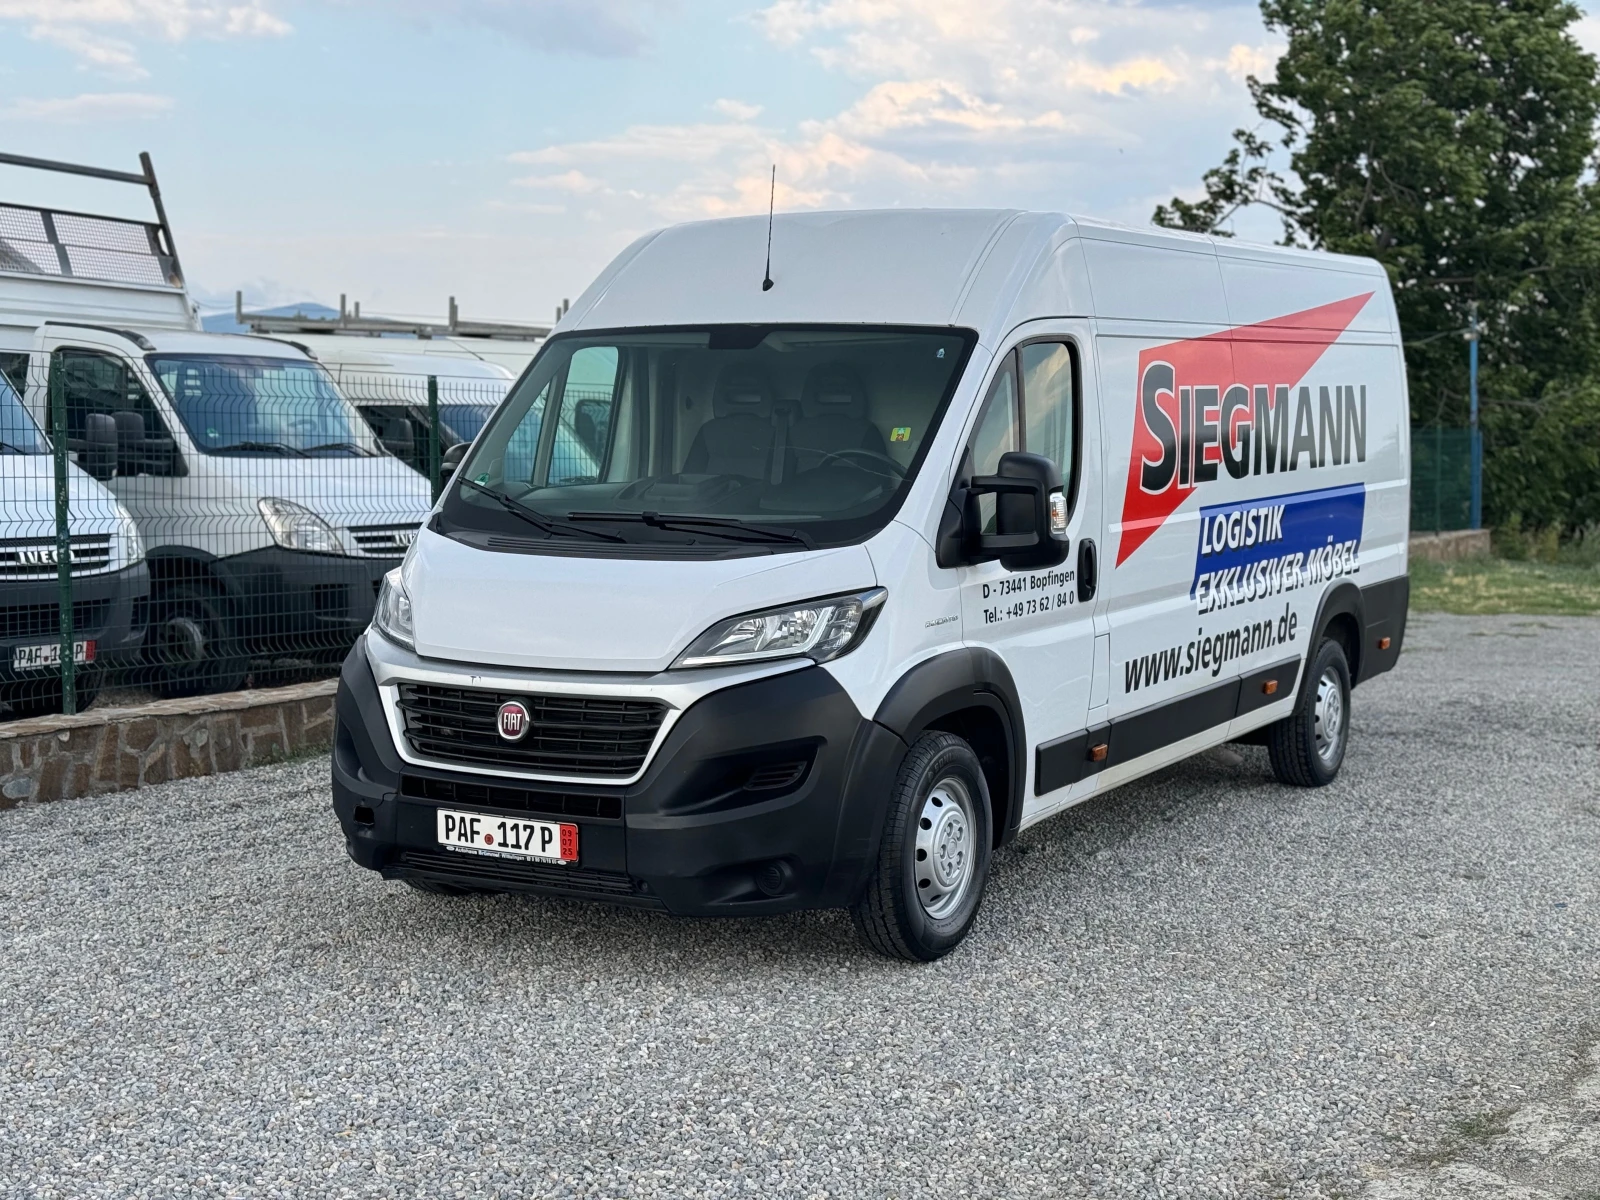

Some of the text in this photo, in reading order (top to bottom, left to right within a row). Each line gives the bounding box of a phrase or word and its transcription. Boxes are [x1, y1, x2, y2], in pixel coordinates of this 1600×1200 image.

[1201, 504, 1286, 555] LOGISTIK
[982, 583, 990, 599] D
[1000, 577, 1027, 596] 73441
[1030, 570, 1075, 592] Bopfingen
[1195, 535, 1361, 615] EXKLUSIVER MÖBEL
[983, 606, 1003, 624] Tel.:
[1006, 602, 1024, 619] +49
[1026, 599, 1037, 615] 73
[1039, 596, 1050, 612] 62
[1056, 592, 1067, 608] 84
[1069, 590, 1075, 605] 0
[18, 647, 42, 665] PAF
[1124, 602, 1298, 694] www.siegmann.de
[503, 712, 522, 731] FIAT
[444, 814, 553, 852] PAF 117 P
[562, 829, 572, 837] 09
[562, 838, 572, 847] 07
[563, 847, 573, 856] 25
